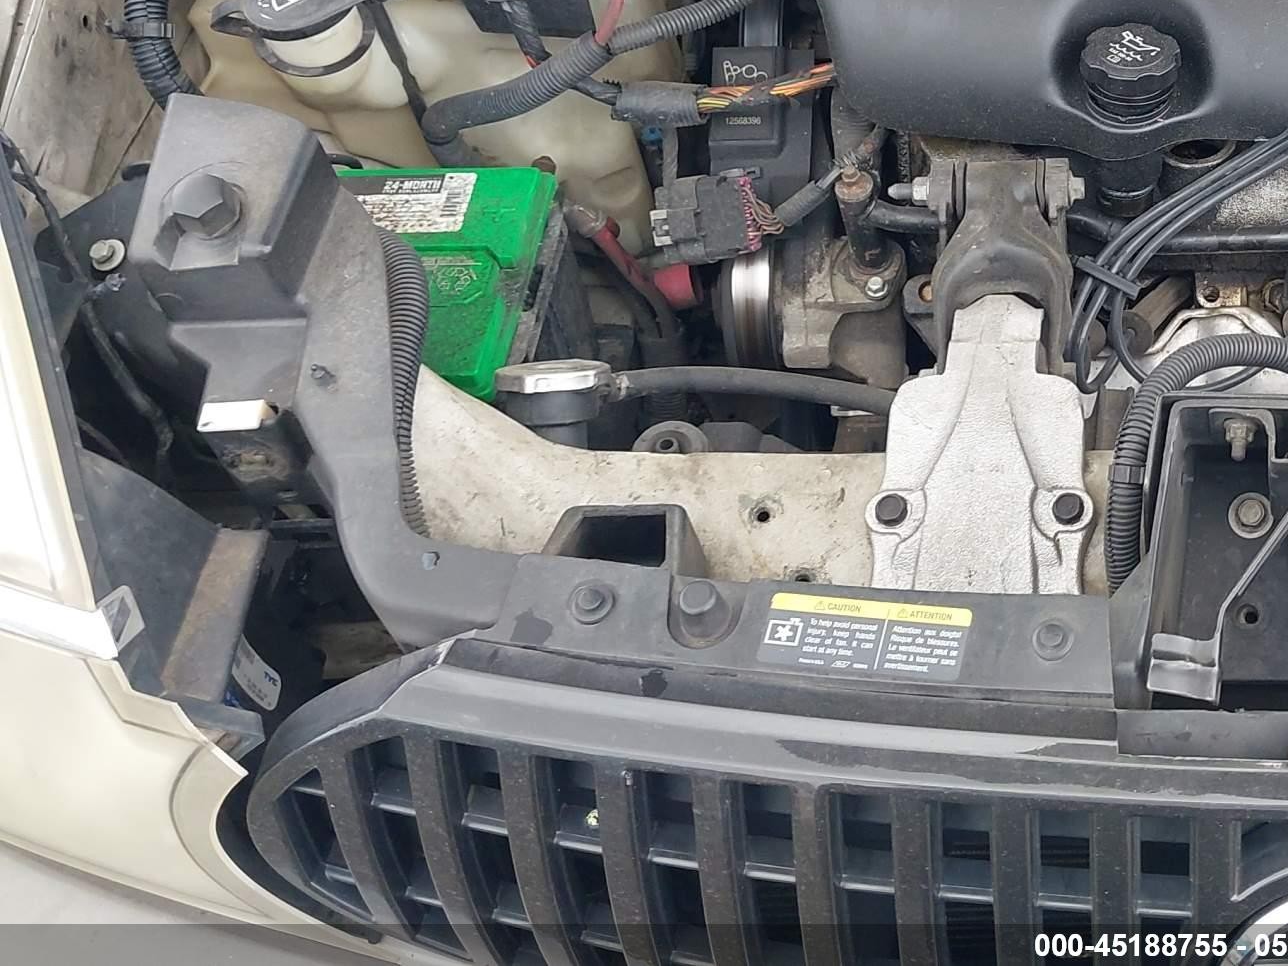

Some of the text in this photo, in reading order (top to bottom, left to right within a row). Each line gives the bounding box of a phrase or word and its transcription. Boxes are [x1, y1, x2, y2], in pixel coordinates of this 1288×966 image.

[726, 117, 761, 125] 12568396
[384, 180, 441, 190] 24-MONTH
[827, 603, 861, 613] CAUTION
[910, 610, 953, 621] ATTENTION
[818, 619, 833, 627] help
[888, 643, 897, 651] Le
